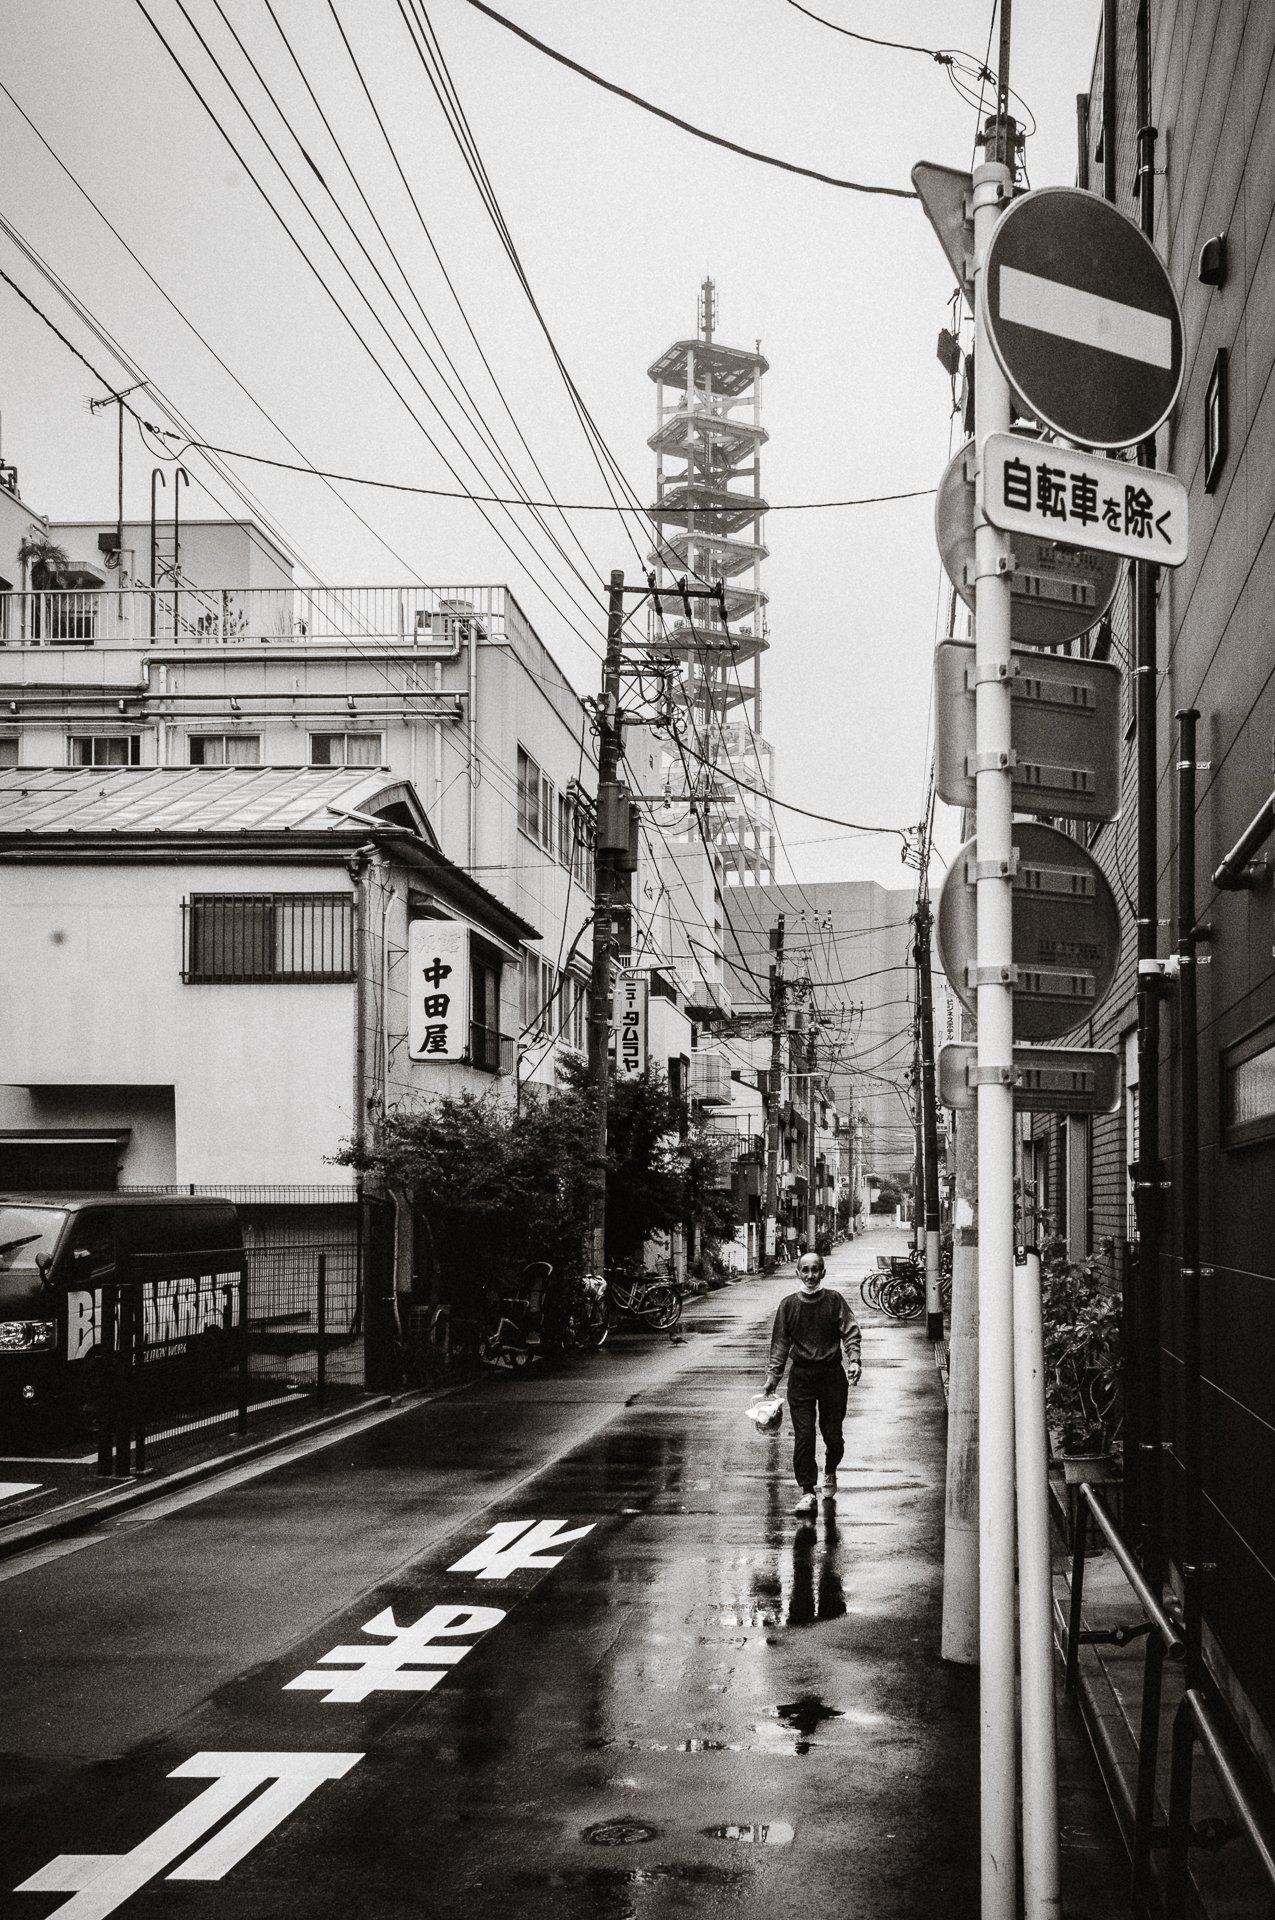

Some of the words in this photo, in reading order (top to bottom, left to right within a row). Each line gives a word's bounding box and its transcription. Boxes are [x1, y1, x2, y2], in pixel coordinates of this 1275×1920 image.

[1004, 457, 1172, 545] 自転車を除く
[417, 957, 453, 1055] 中田屋
